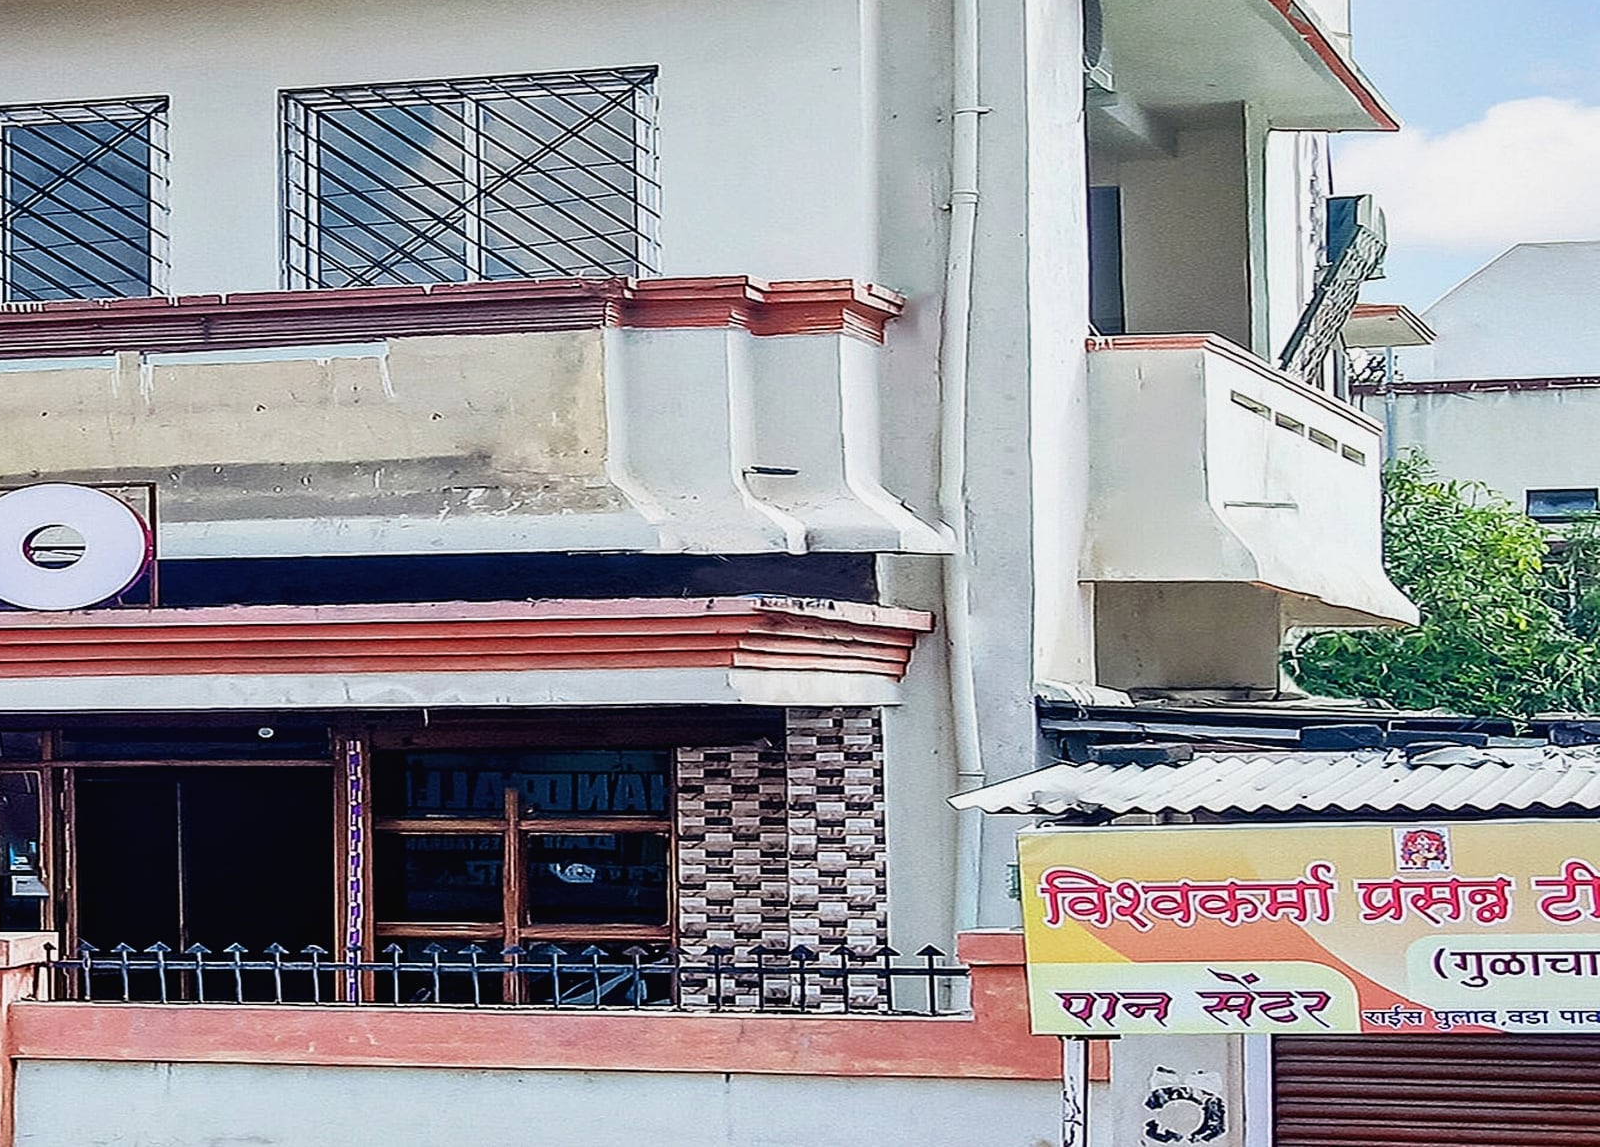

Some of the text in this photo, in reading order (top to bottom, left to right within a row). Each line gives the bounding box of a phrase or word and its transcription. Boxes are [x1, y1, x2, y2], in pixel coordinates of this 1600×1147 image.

[1039, 862, 1335, 930] विश्वकर्मा
[1054, 967, 1333, 1028] पान सेंटर
